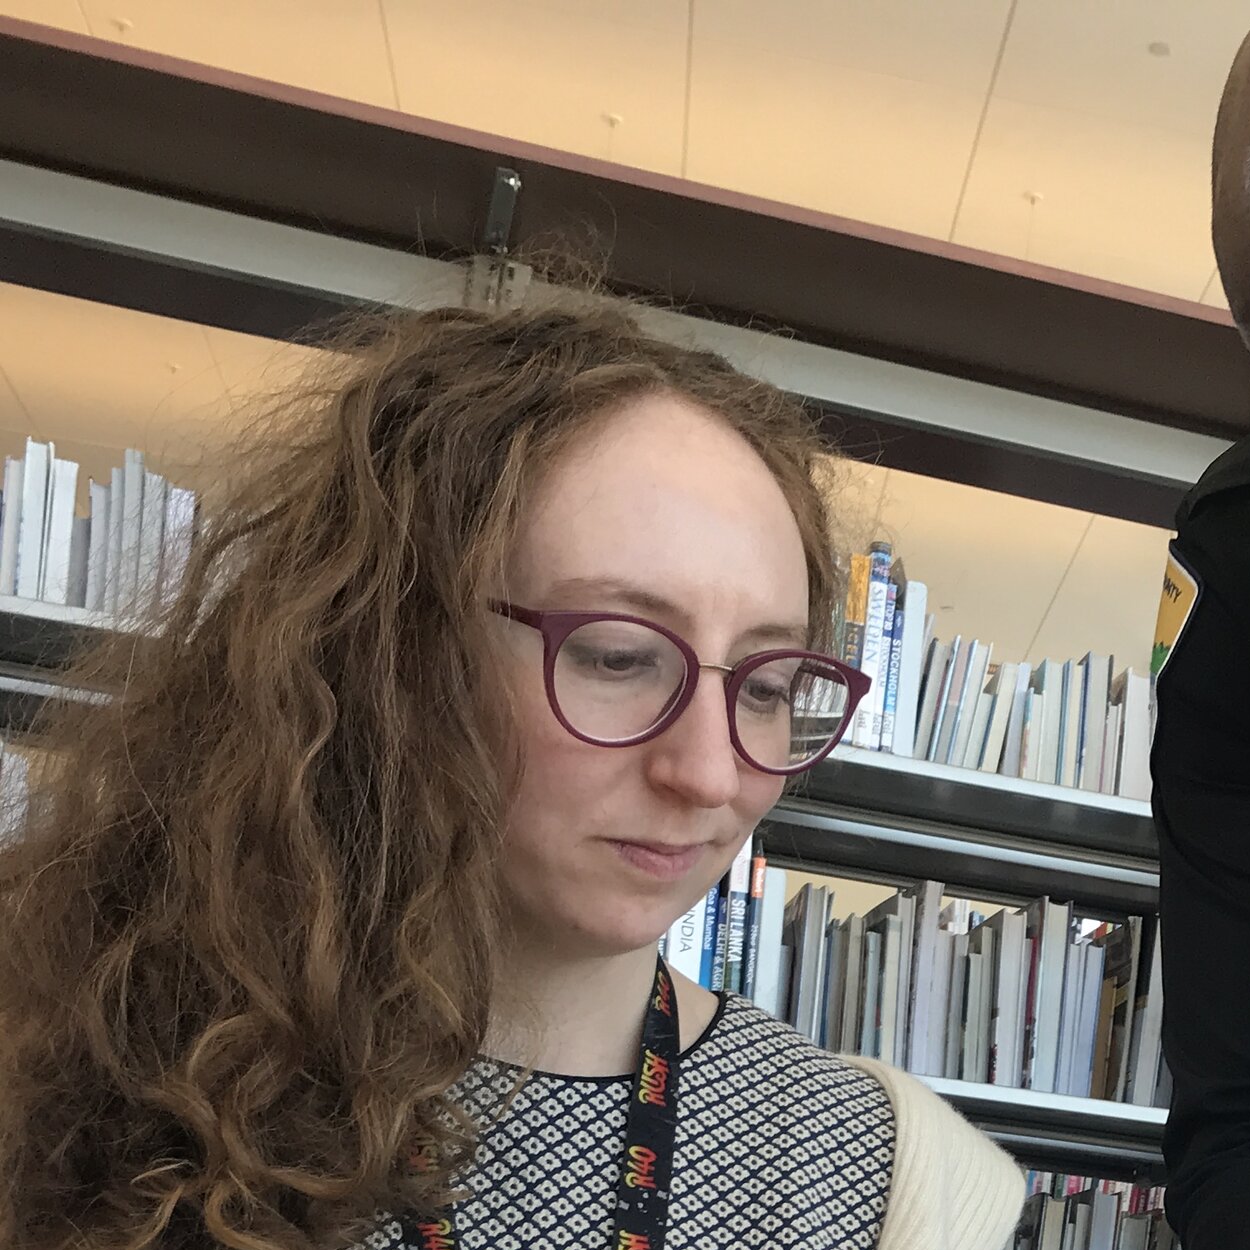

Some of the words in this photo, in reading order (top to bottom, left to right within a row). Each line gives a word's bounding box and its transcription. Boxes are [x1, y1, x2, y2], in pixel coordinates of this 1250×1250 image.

[864, 586, 884, 662] SWEDEN
[886, 638, 902, 707] STOCKHOLM
[708, 904, 716, 914] &
[710, 887, 718, 905] Goa
[730, 899, 746, 918] SRI
[704, 914, 715, 951] Mumbai
[717, 923, 727, 955] DELHI
[727, 919, 744, 962] LANKA
[711, 964, 723, 992] AGR
[638, 1049, 669, 1108] RUSH
[625, 1145, 657, 1189] R40
